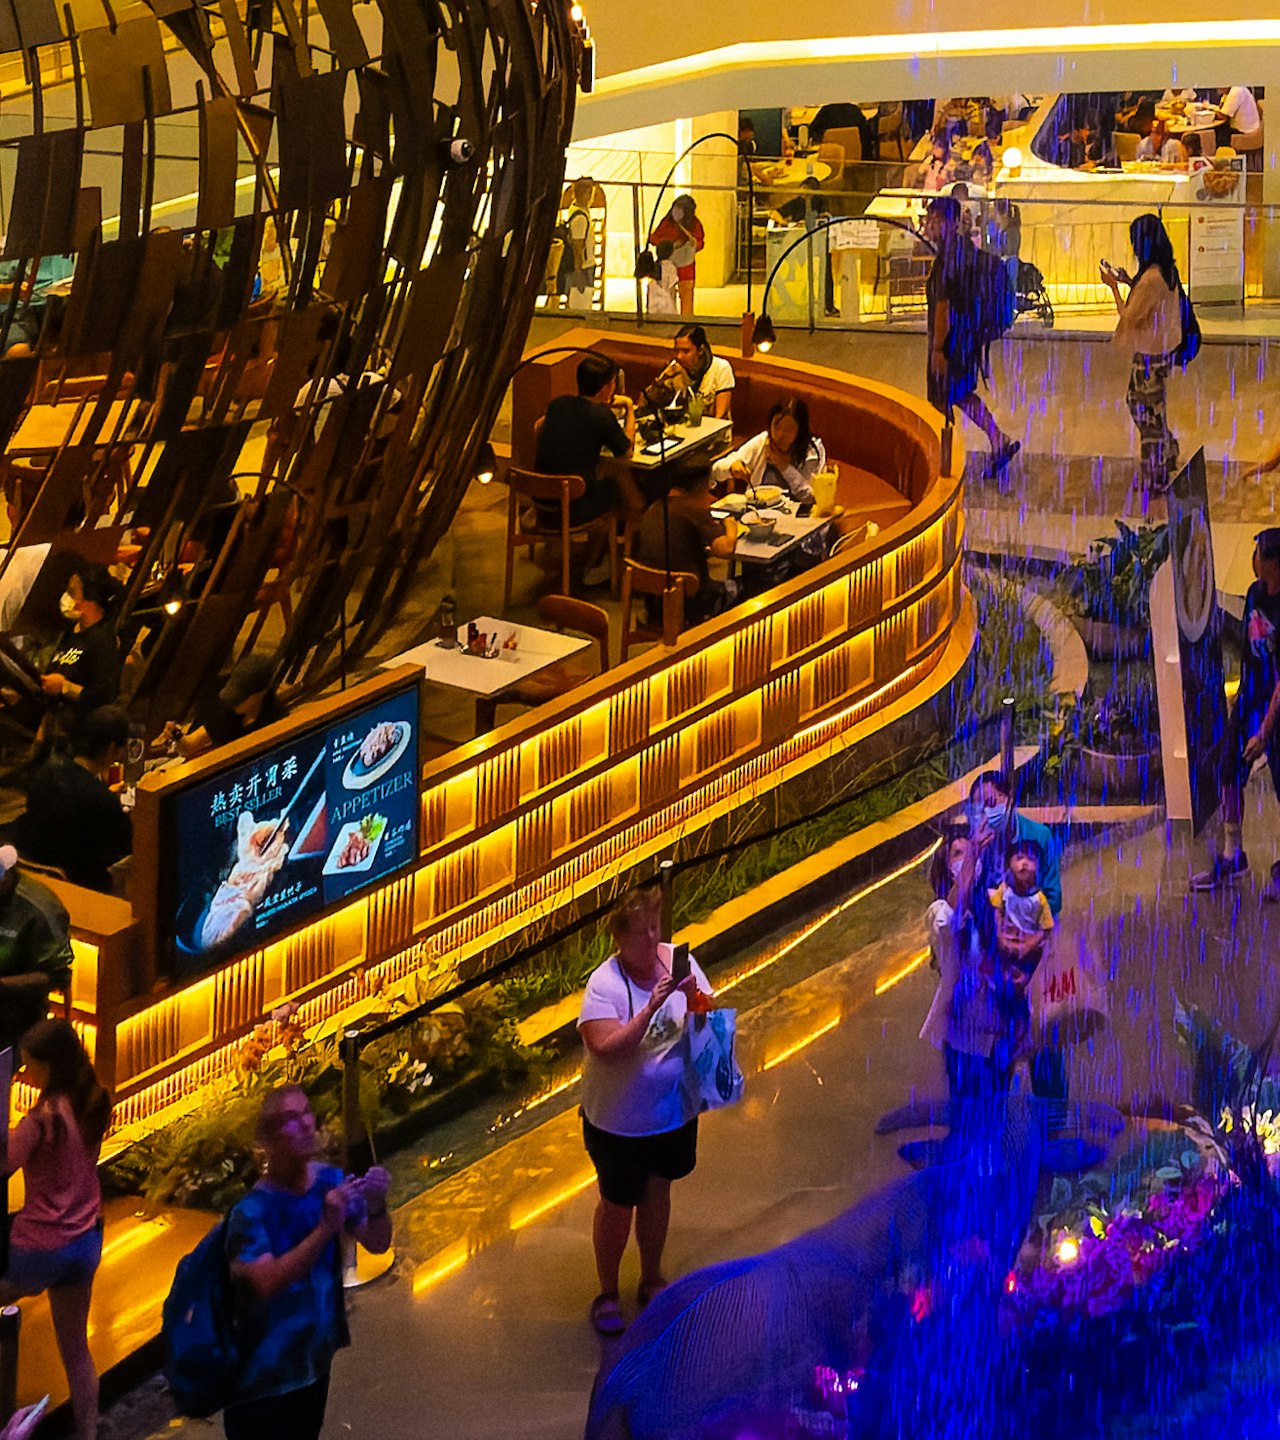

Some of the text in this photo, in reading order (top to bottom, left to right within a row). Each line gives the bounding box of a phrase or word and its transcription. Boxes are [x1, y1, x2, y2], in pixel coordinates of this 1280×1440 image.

[214, 786, 283, 828] BEST SELLER
[330, 770, 414, 824] APPETIZER
